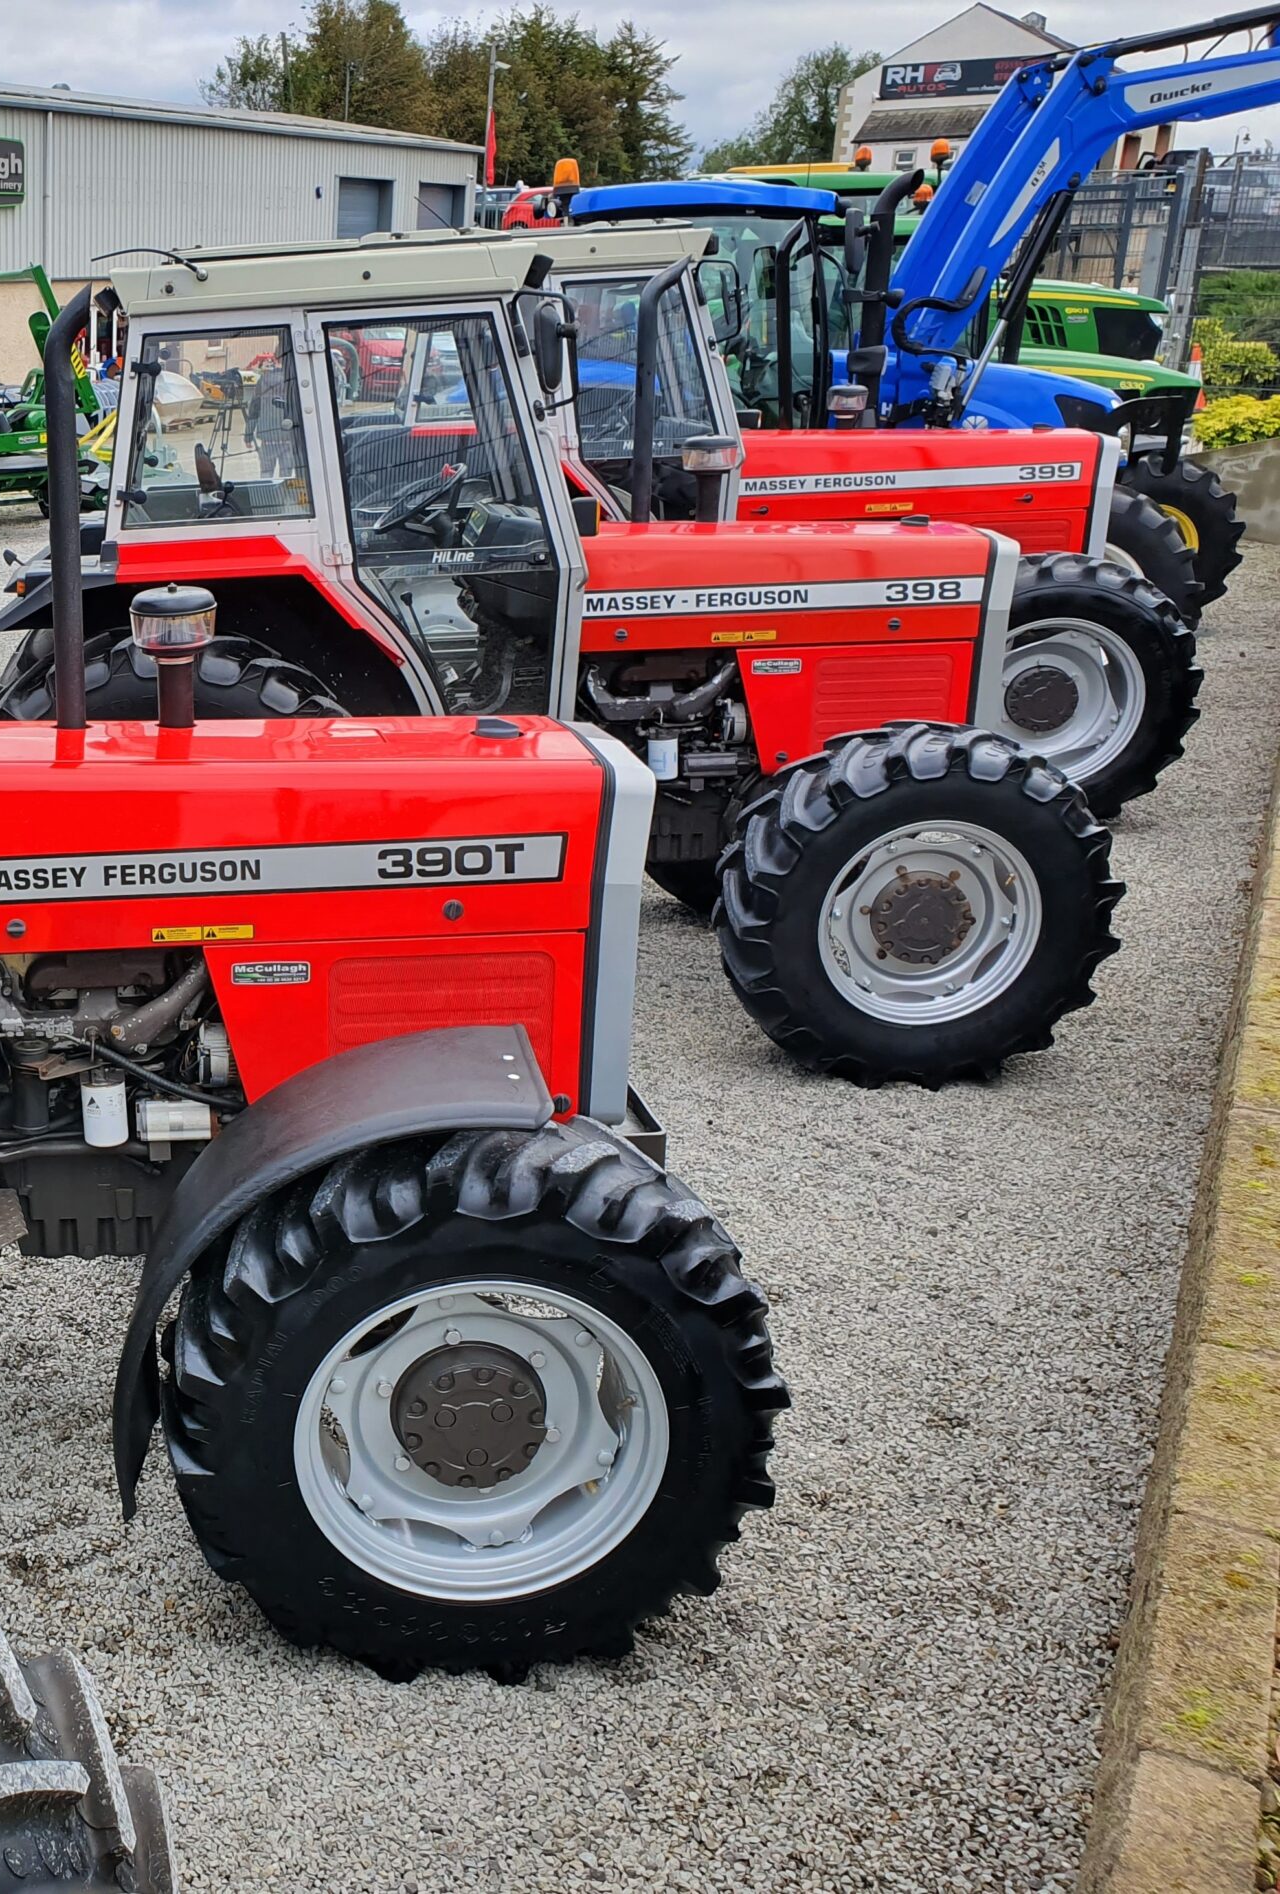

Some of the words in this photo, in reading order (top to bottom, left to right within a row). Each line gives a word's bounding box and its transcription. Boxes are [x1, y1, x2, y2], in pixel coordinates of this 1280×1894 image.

[897, 83, 946, 93] AUTOS
[1149, 82, 1212, 104] Quicke
[243, 375, 255, 383] NC
[1120, 381, 1145, 390] 6330
[744, 477, 807, 493] MASSEY
[814, 474, 896, 489] FERGUSON
[1019, 464, 1075, 481] 399
[432, 551, 475, 563] HiLine
[585, 594, 675, 613] MASSEY
[694, 588, 809, 608] FERGUSON
[885, 581, 962, 602] 398
[102, 859, 261, 888] FERGUSON
[377, 842, 525, 879] 390T
[235, 964, 306, 973] McCullagh
